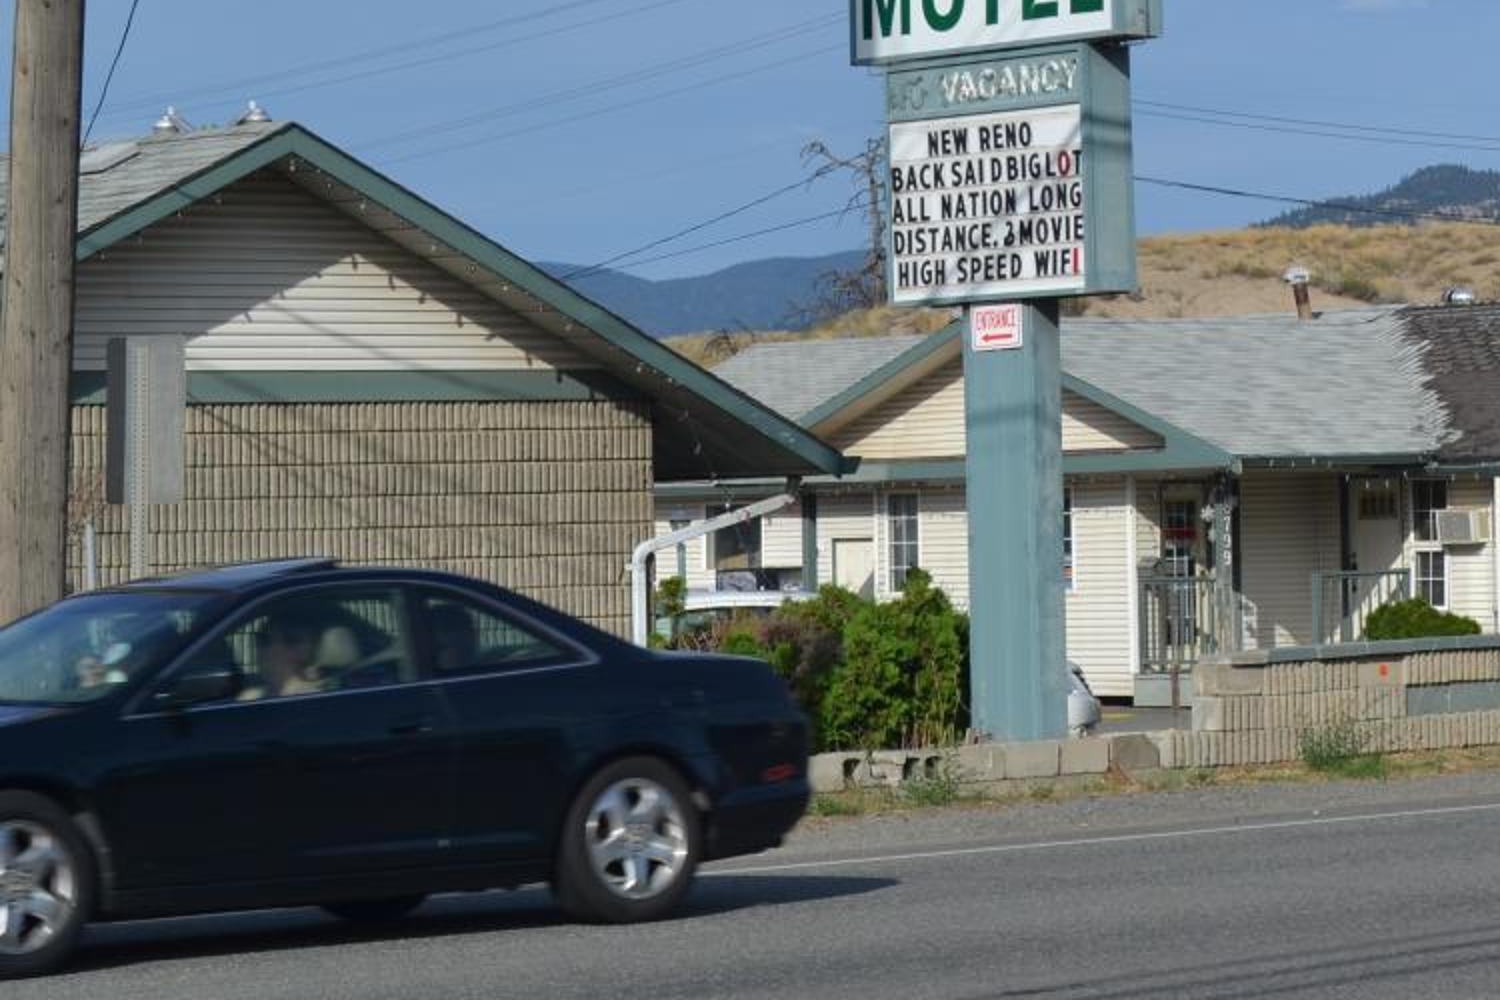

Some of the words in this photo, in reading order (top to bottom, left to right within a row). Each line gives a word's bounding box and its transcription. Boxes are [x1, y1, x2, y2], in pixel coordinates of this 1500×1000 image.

[940, 57, 1079, 104] VACANCY
[928, 128, 967, 157] NEW
[979, 121, 1031, 151] RENO
[892, 163, 945, 192] BACK
[1007, 152, 1041, 181] BIG
[1046, 150, 1082, 177] LOT
[893, 197, 931, 223] ALL
[941, 188, 1017, 219] NATION
[1029, 182, 1082, 212] LONG
[894, 223, 998, 255] DISTANCE.
[898, 259, 945, 287] HIGH
[957, 253, 1023, 284] SPEED
[1034, 247, 1080, 277] WIFI
[975, 308, 1015, 330] ENTRANCE
